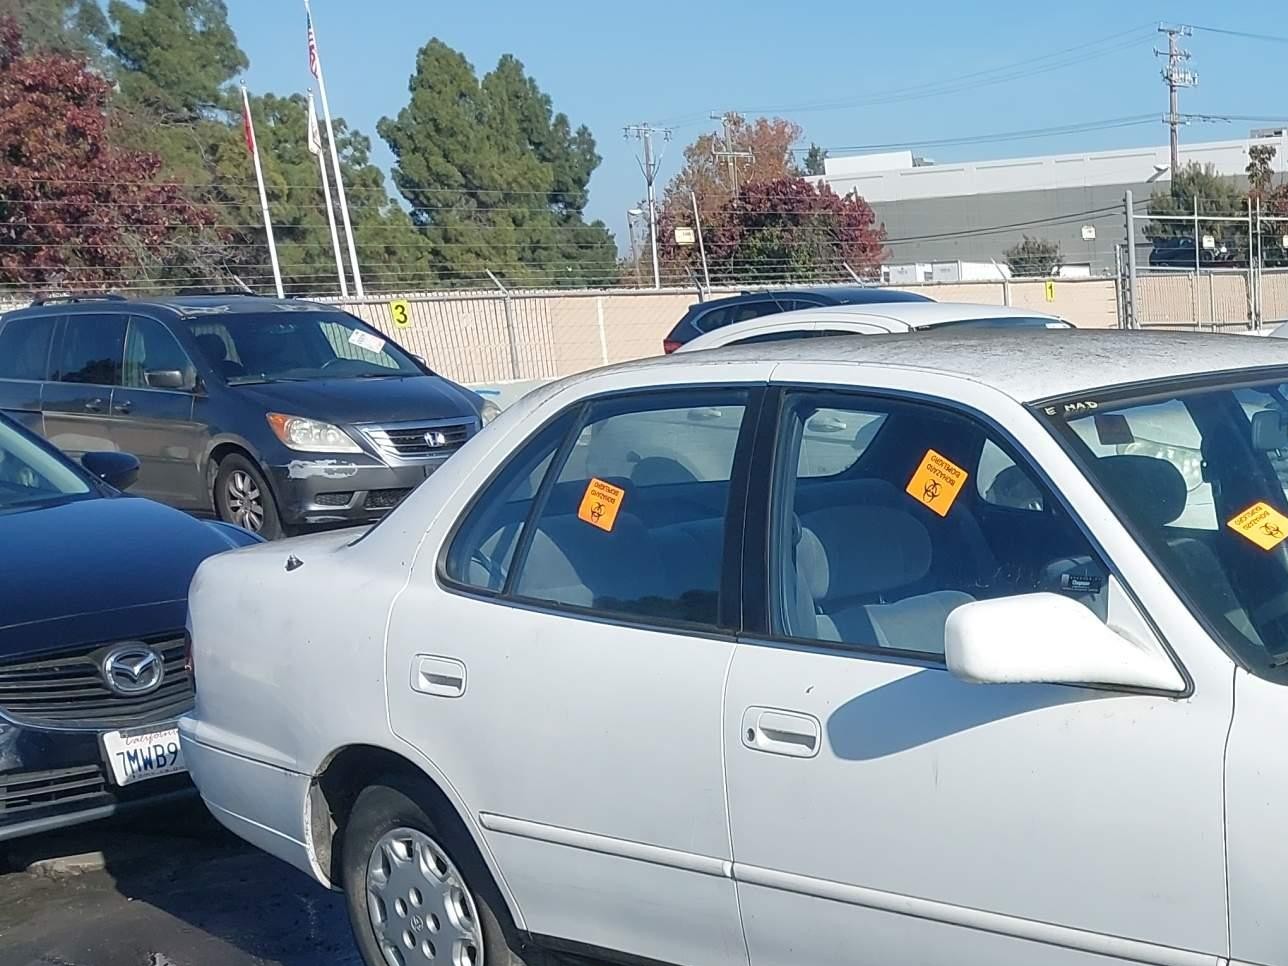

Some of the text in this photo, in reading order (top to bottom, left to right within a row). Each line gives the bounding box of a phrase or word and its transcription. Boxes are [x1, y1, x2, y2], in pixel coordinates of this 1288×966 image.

[395, 304, 408, 324] 3
[926, 463, 956, 487] BIOHAZARD
[930, 455, 961, 479] BIOPELIGRO
[590, 489, 616, 505] BIOHAZARD
[116, 742, 178, 777] 7MWB9
